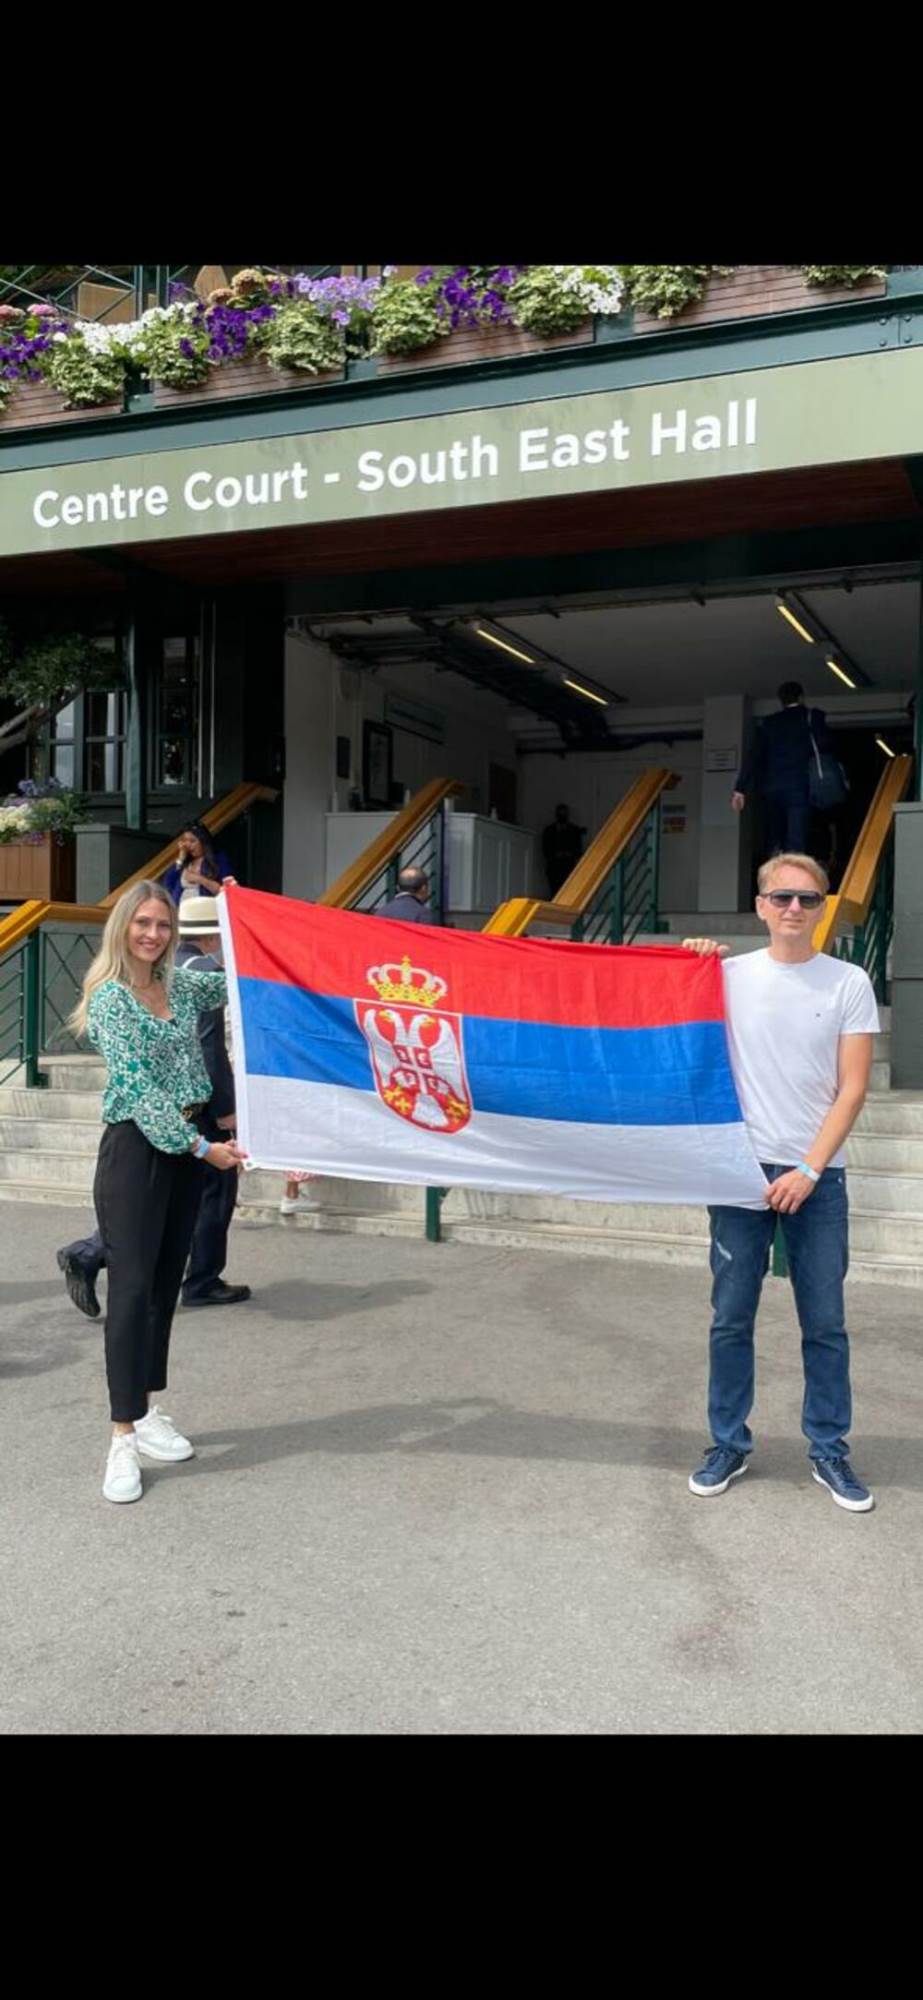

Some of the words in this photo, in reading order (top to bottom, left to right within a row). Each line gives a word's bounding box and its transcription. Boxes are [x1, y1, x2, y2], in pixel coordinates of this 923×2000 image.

[33, 484, 169, 528] Centre
[184, 462, 308, 511] Court
[357, 435, 499, 492] South
[519, 419, 630, 472] East
[651, 397, 758, 456] Hall
